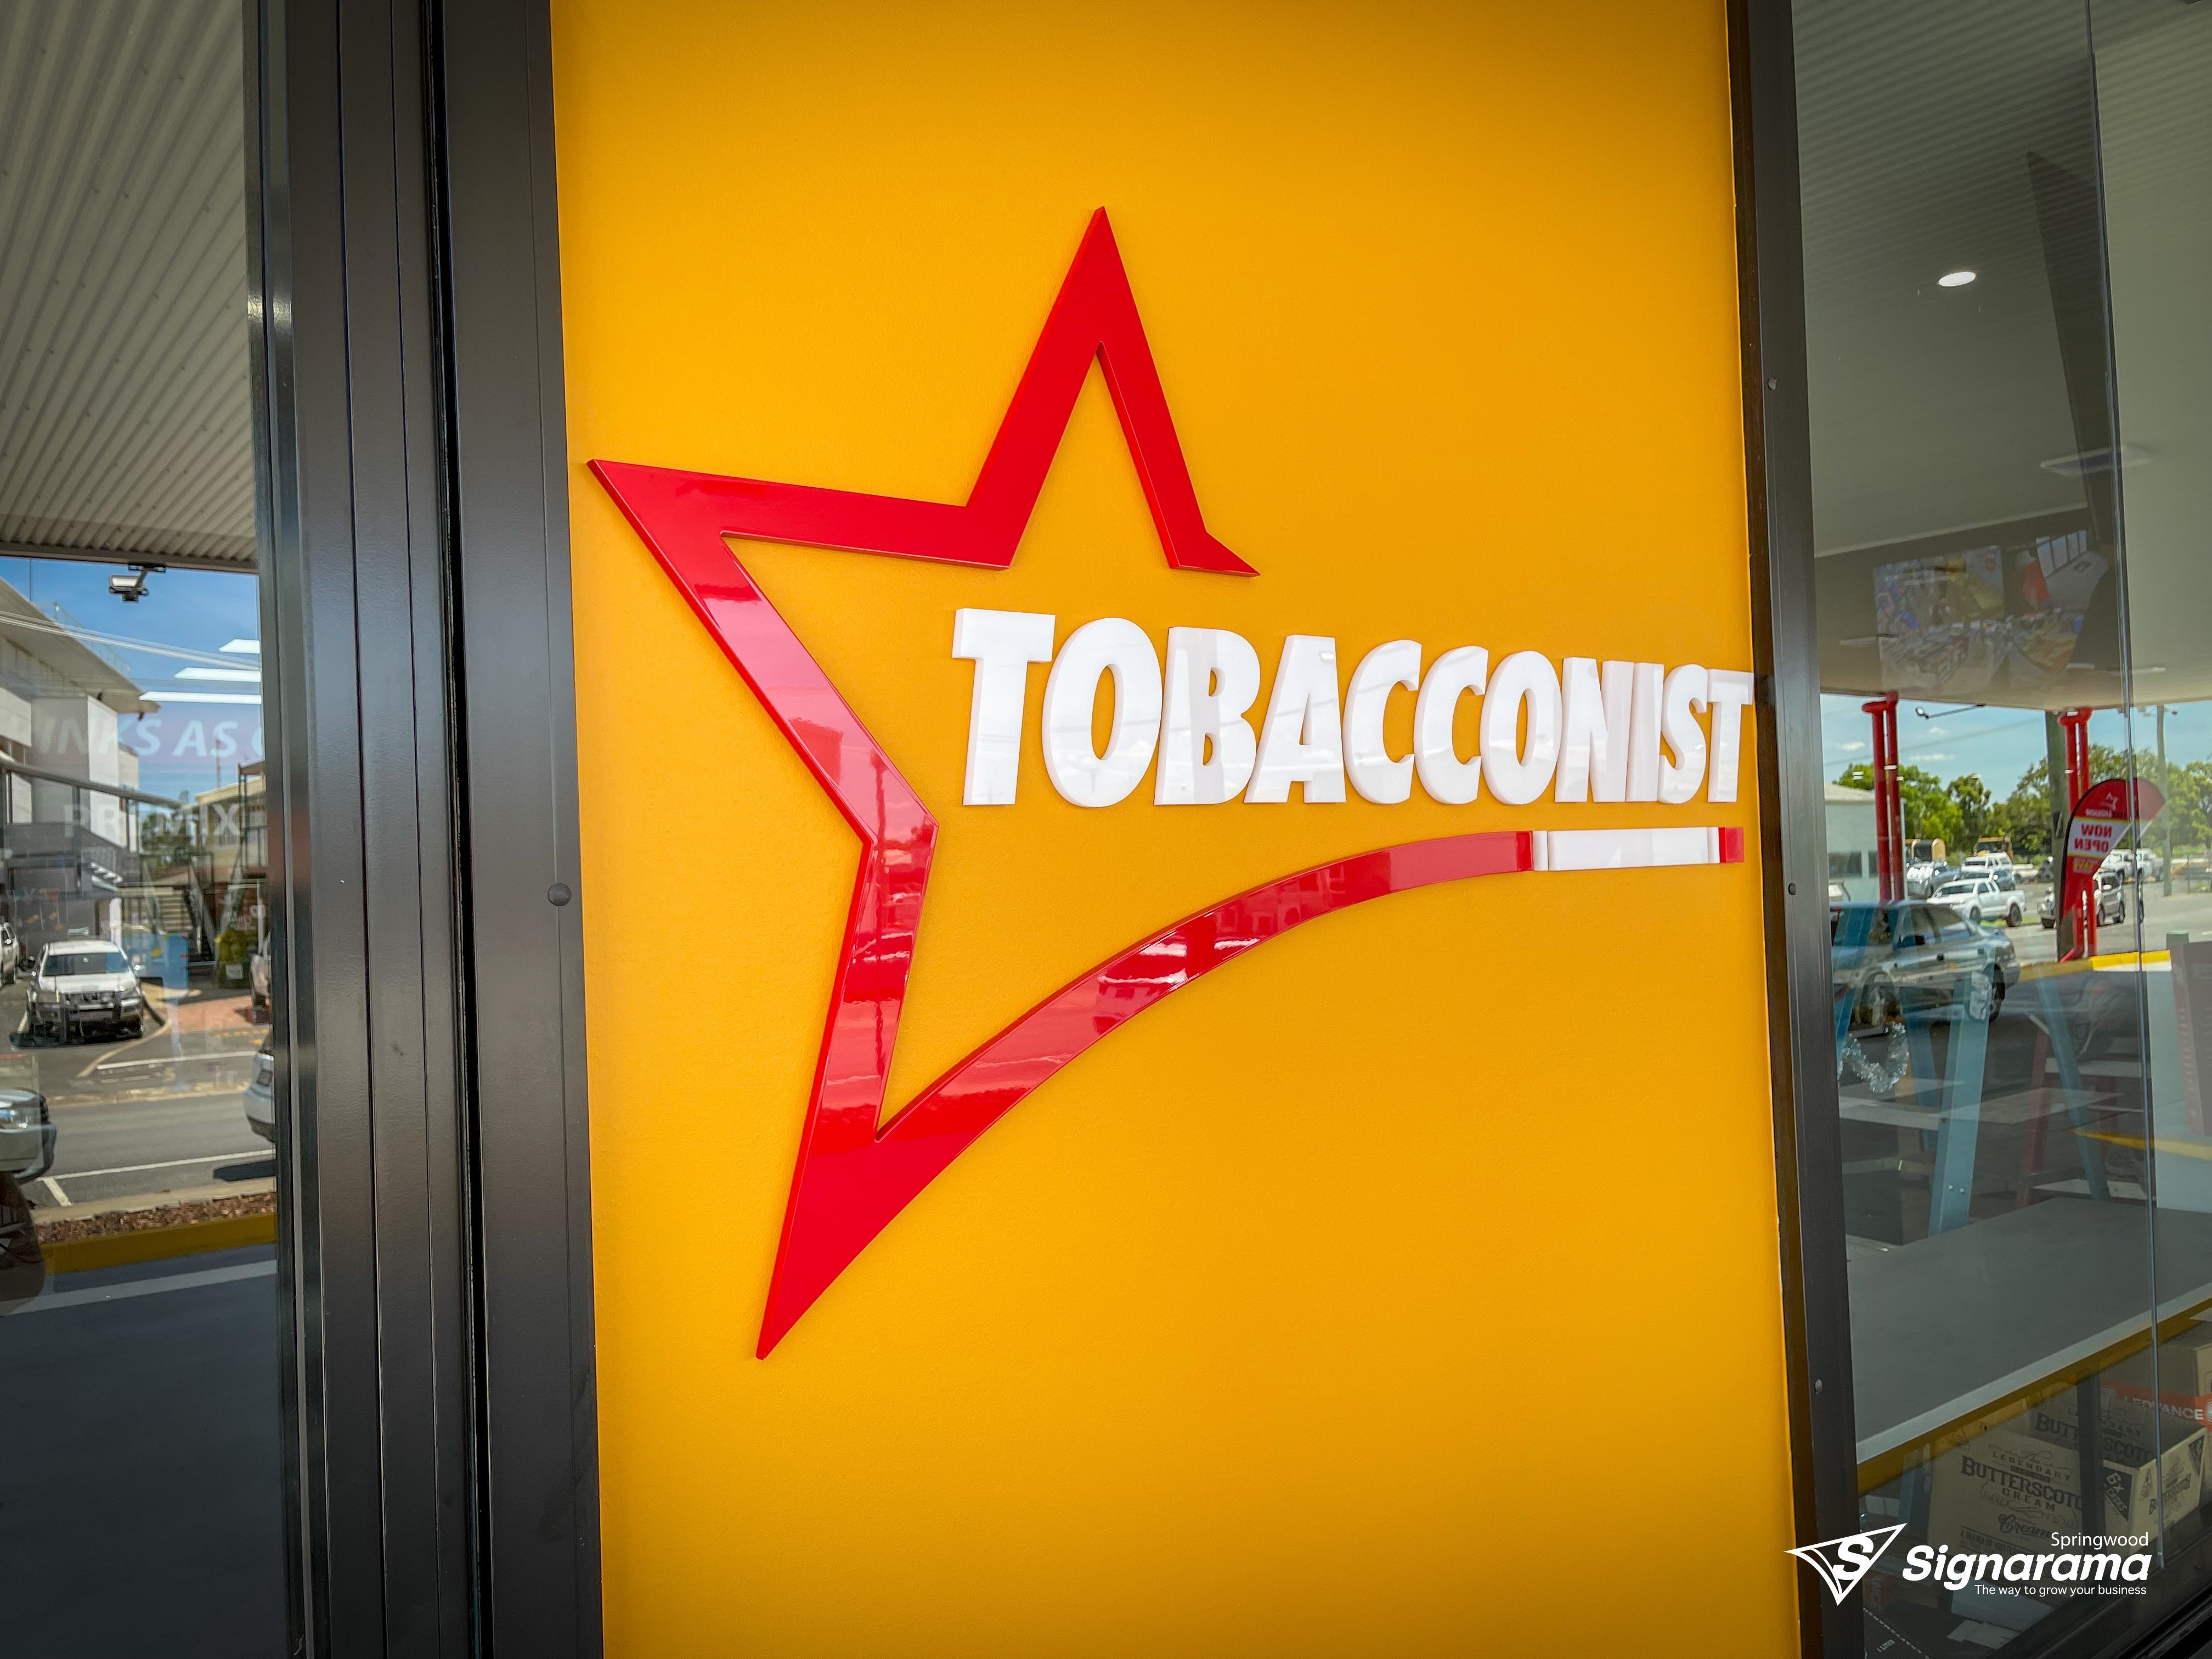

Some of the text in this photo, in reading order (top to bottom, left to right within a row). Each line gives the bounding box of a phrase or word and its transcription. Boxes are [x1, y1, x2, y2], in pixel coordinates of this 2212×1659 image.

[952, 608, 1753, 808] TOBACCONIST
[171, 719, 239, 758] AS
[64, 803, 240, 837] PRMIX
[1992, 1451, 2072, 1482] LEGENDARY
[2002, 1487, 2055, 1512] CREAM
